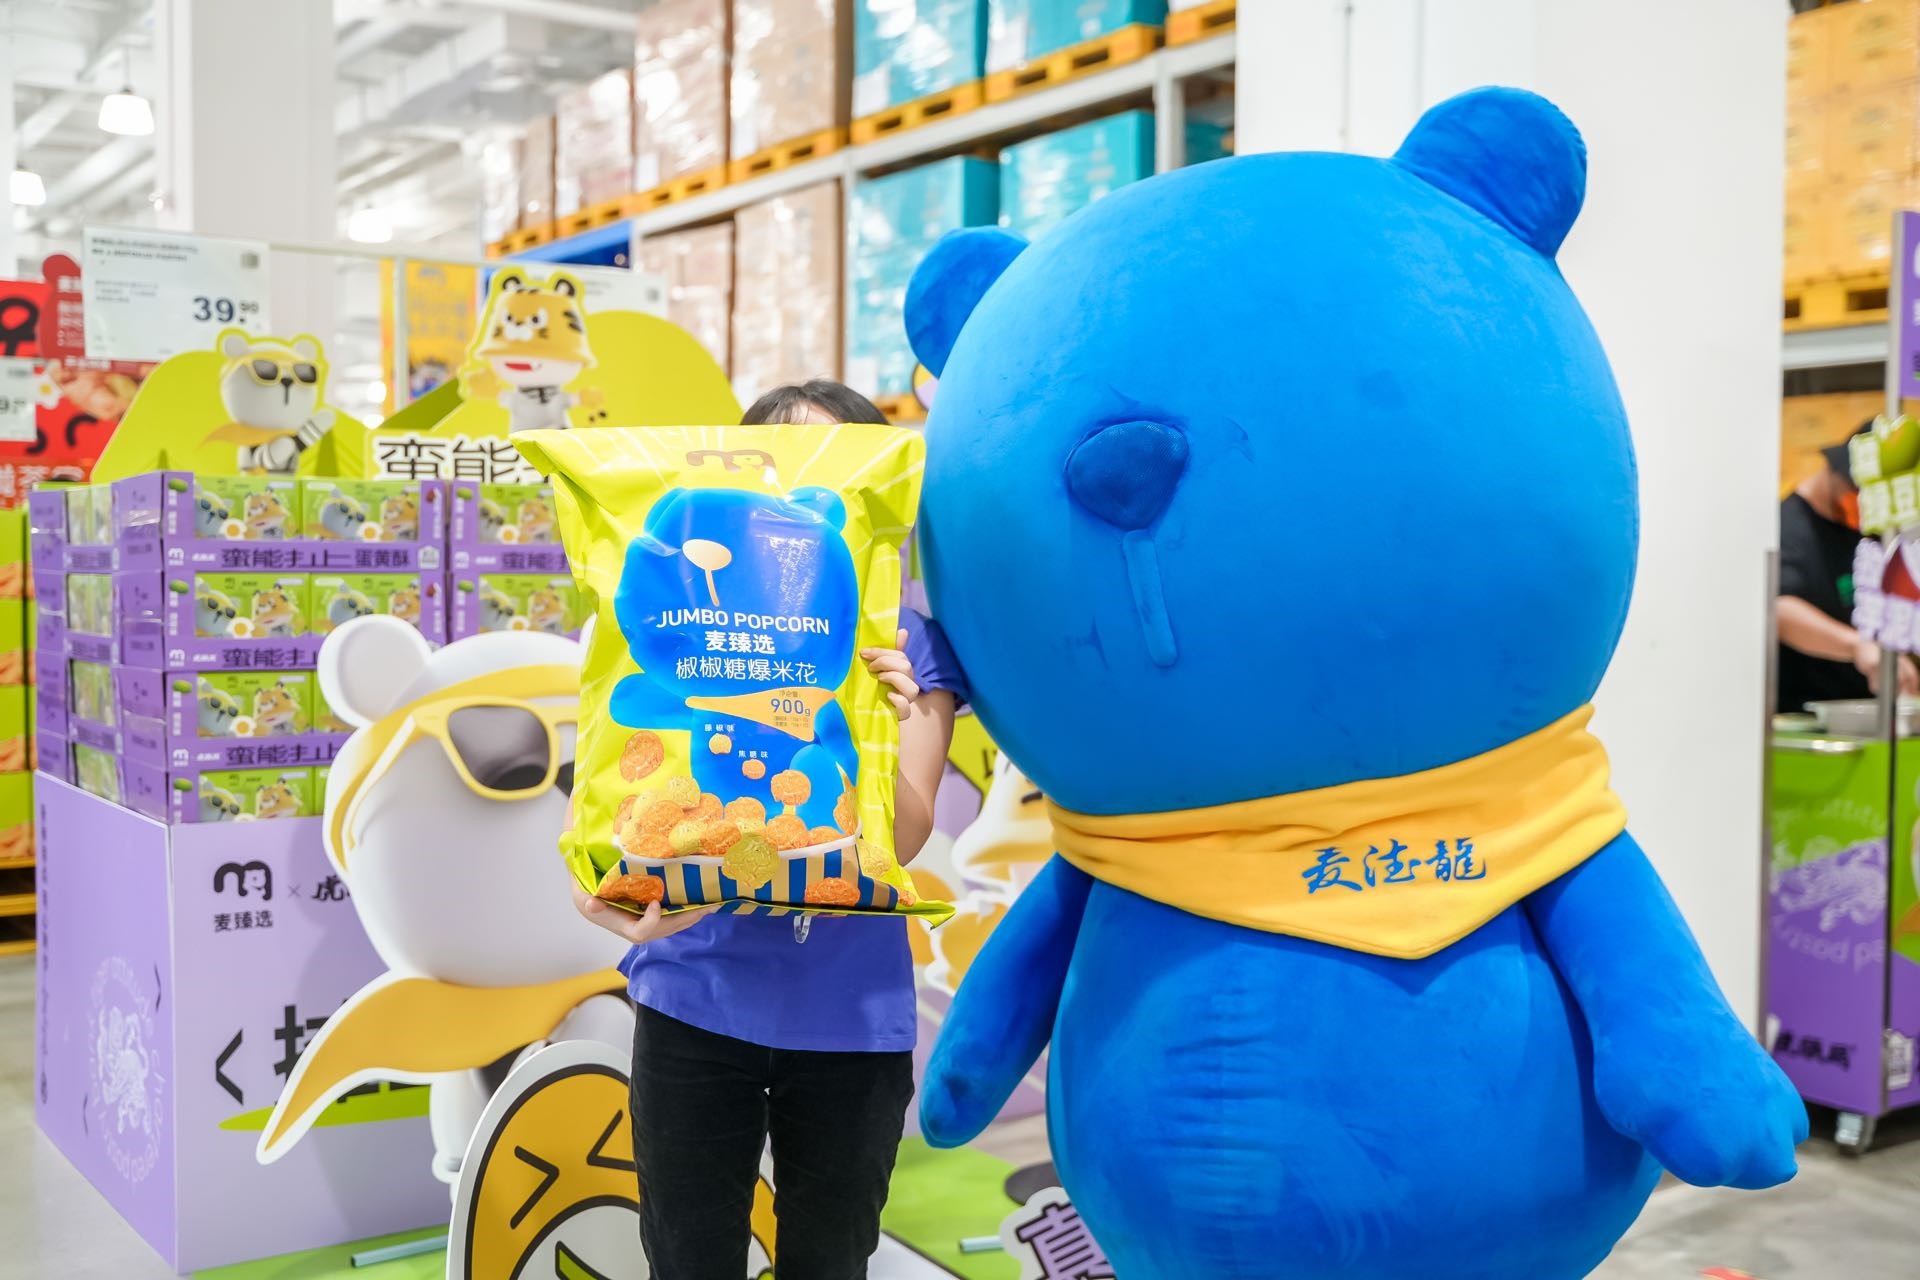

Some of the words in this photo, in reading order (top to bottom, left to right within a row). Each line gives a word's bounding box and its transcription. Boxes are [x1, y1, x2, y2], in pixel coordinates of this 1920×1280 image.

[379, 438, 549, 482] 蛮能
[656, 608, 728, 628] JUMBO
[734, 612, 830, 635] POPCORN
[705, 630, 776, 655] 麦臻选
[675, 655, 818, 684] 椒椒糖爆米花
[770, 698, 811, 716] 900g
[311, 874, 351, 902] 虎
[214, 910, 273, 933] 麦臻选
